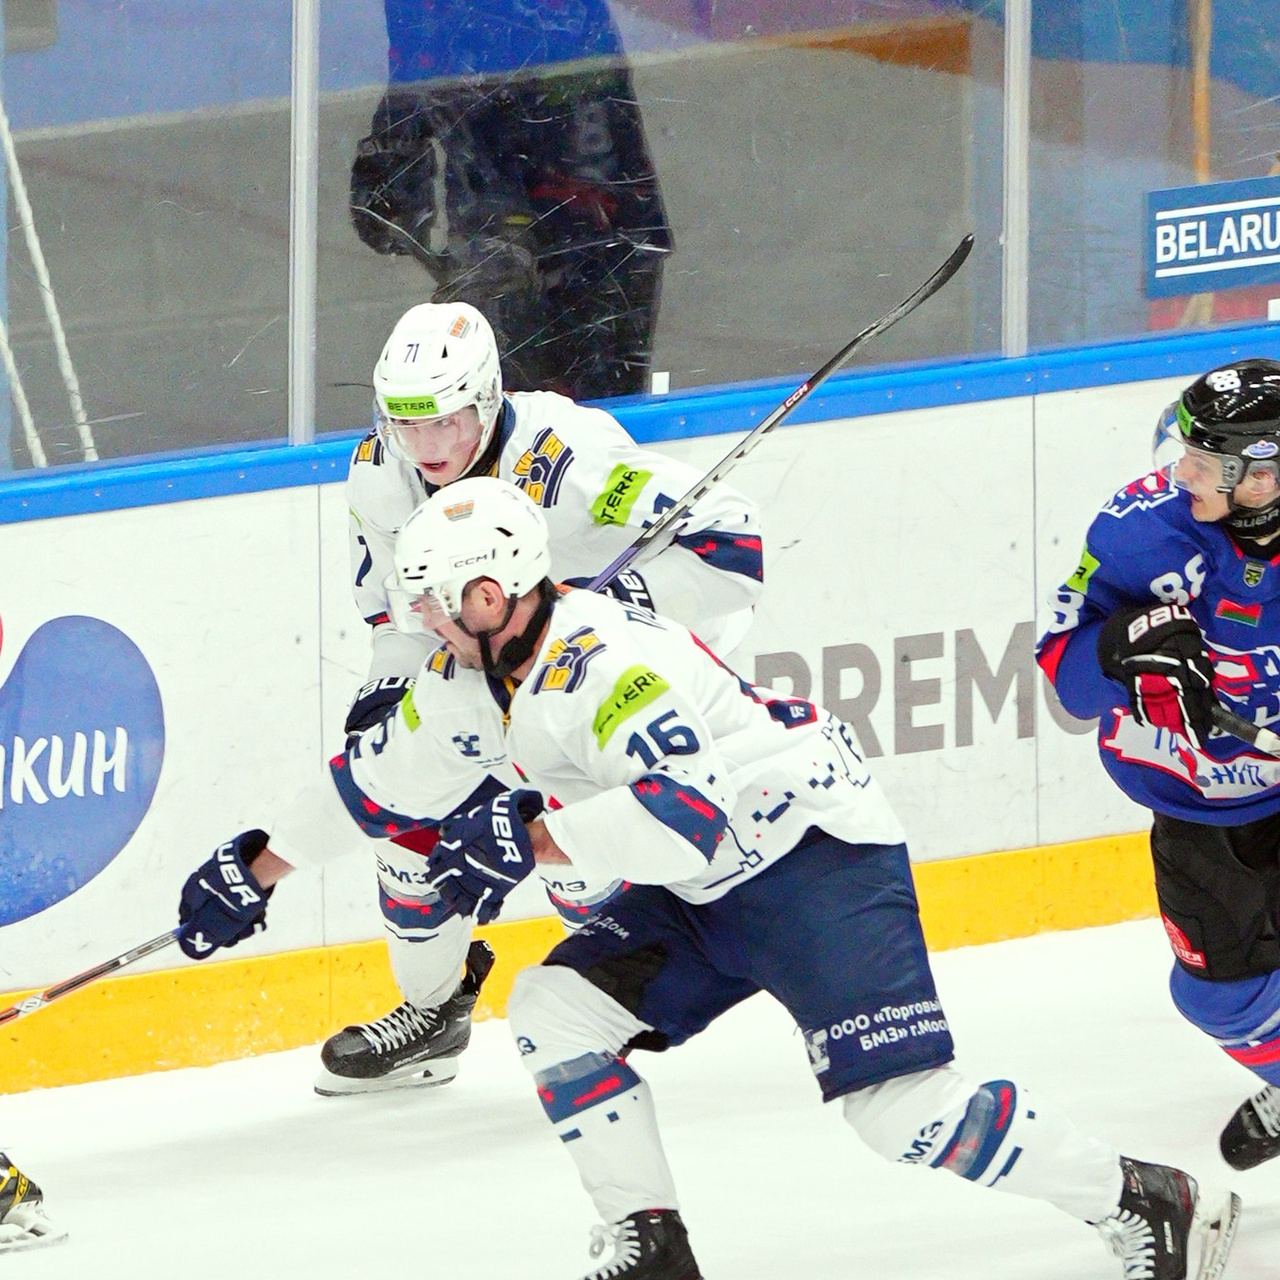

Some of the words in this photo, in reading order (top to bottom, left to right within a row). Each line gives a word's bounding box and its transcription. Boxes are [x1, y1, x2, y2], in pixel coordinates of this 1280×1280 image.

[403, 343, 420, 363] 71
[387, 401, 436, 411] BETERA
[782, 383, 812, 410] CCM
[600, 469, 639, 521] TERA
[453, 553, 488, 568] CCM
[1127, 604, 1192, 645] BAU
[625, 708, 701, 771] 16
[491, 791, 524, 864] UER
[217, 842, 261, 907] UER
[829, 1013, 871, 1041] ООО
[858, 1026, 909, 1052] БМЗ»
